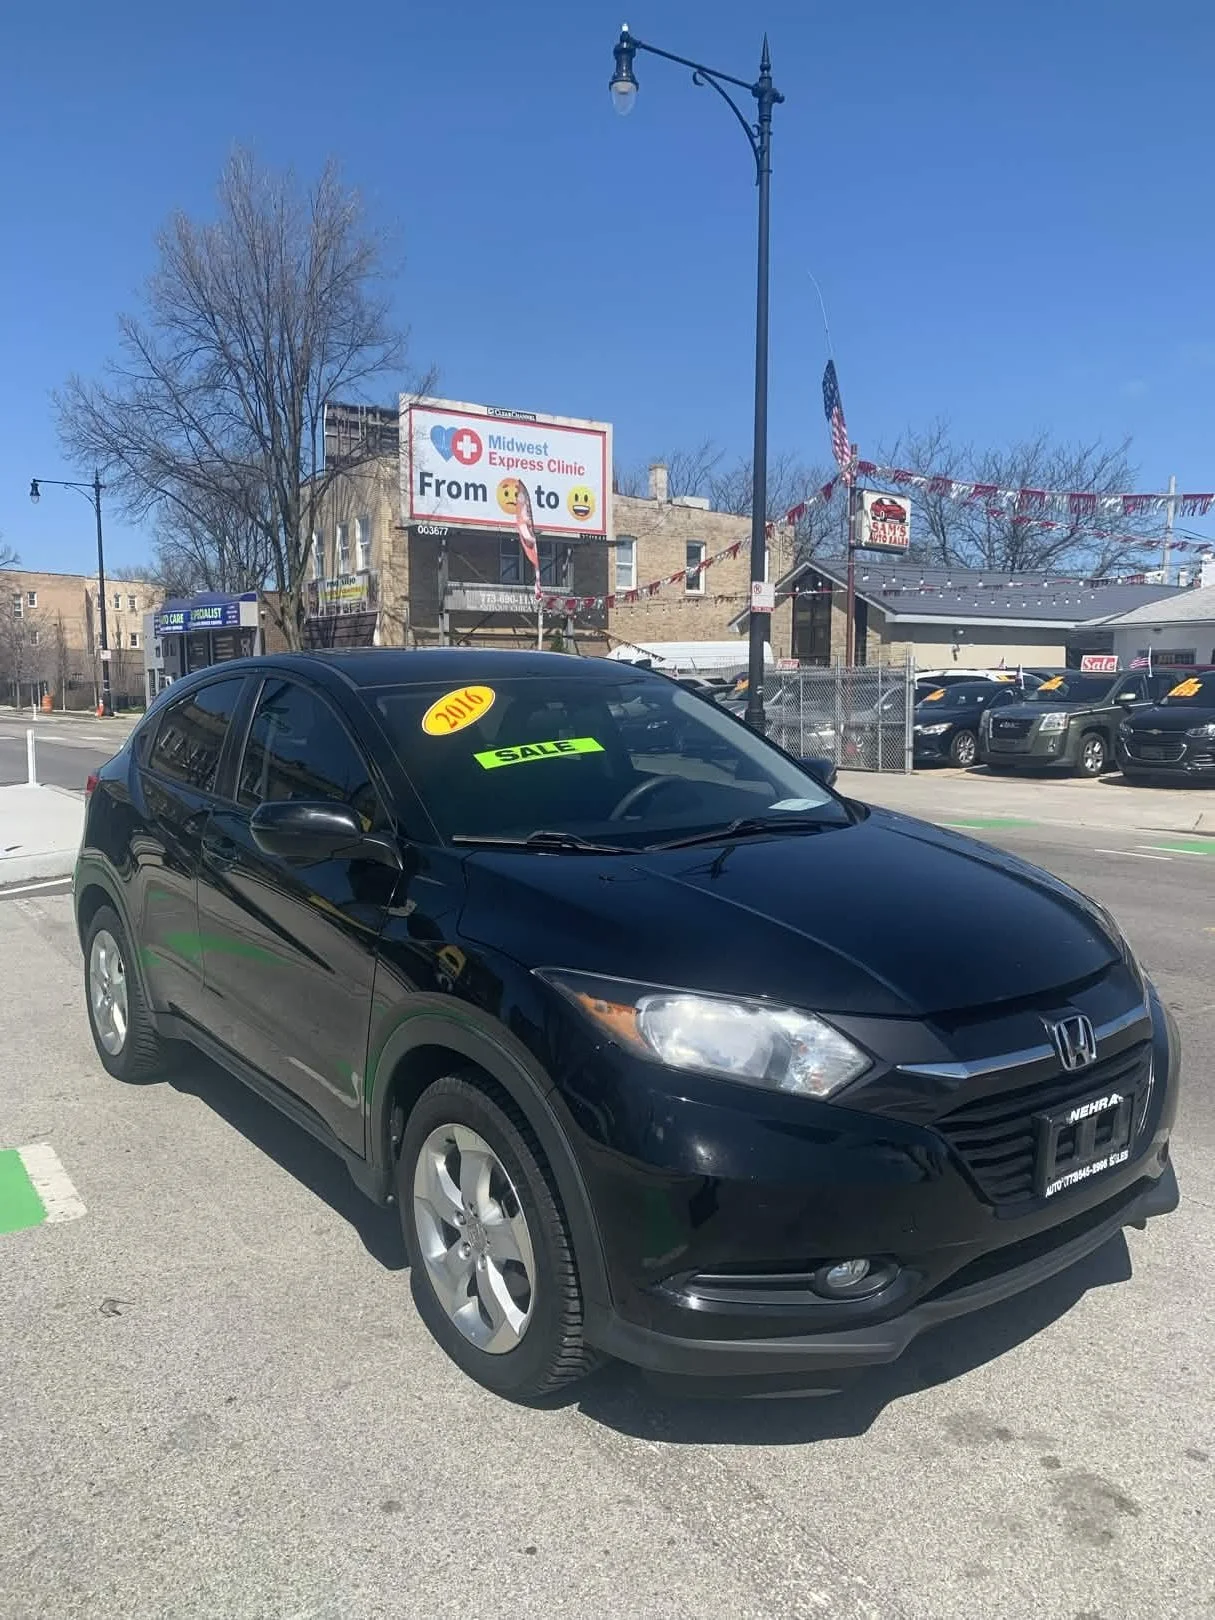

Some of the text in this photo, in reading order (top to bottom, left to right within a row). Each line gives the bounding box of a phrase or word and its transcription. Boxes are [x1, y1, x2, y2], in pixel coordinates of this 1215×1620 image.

[488, 434, 549, 457] Midwest
[488, 452, 585, 476] Express Clinic
[419, 471, 559, 509] From to
[869, 532, 887, 544] AUTO
[872, 522, 906, 537] SAM'S
[170, 613, 184, 624] CARE
[1083, 657, 1115, 670] Sale
[435, 689, 484, 729] 2016
[495, 741, 576, 762] SALE
[1070, 1093, 1121, 1122] NEHRA
[1045, 1178, 1063, 1198] AUTO
